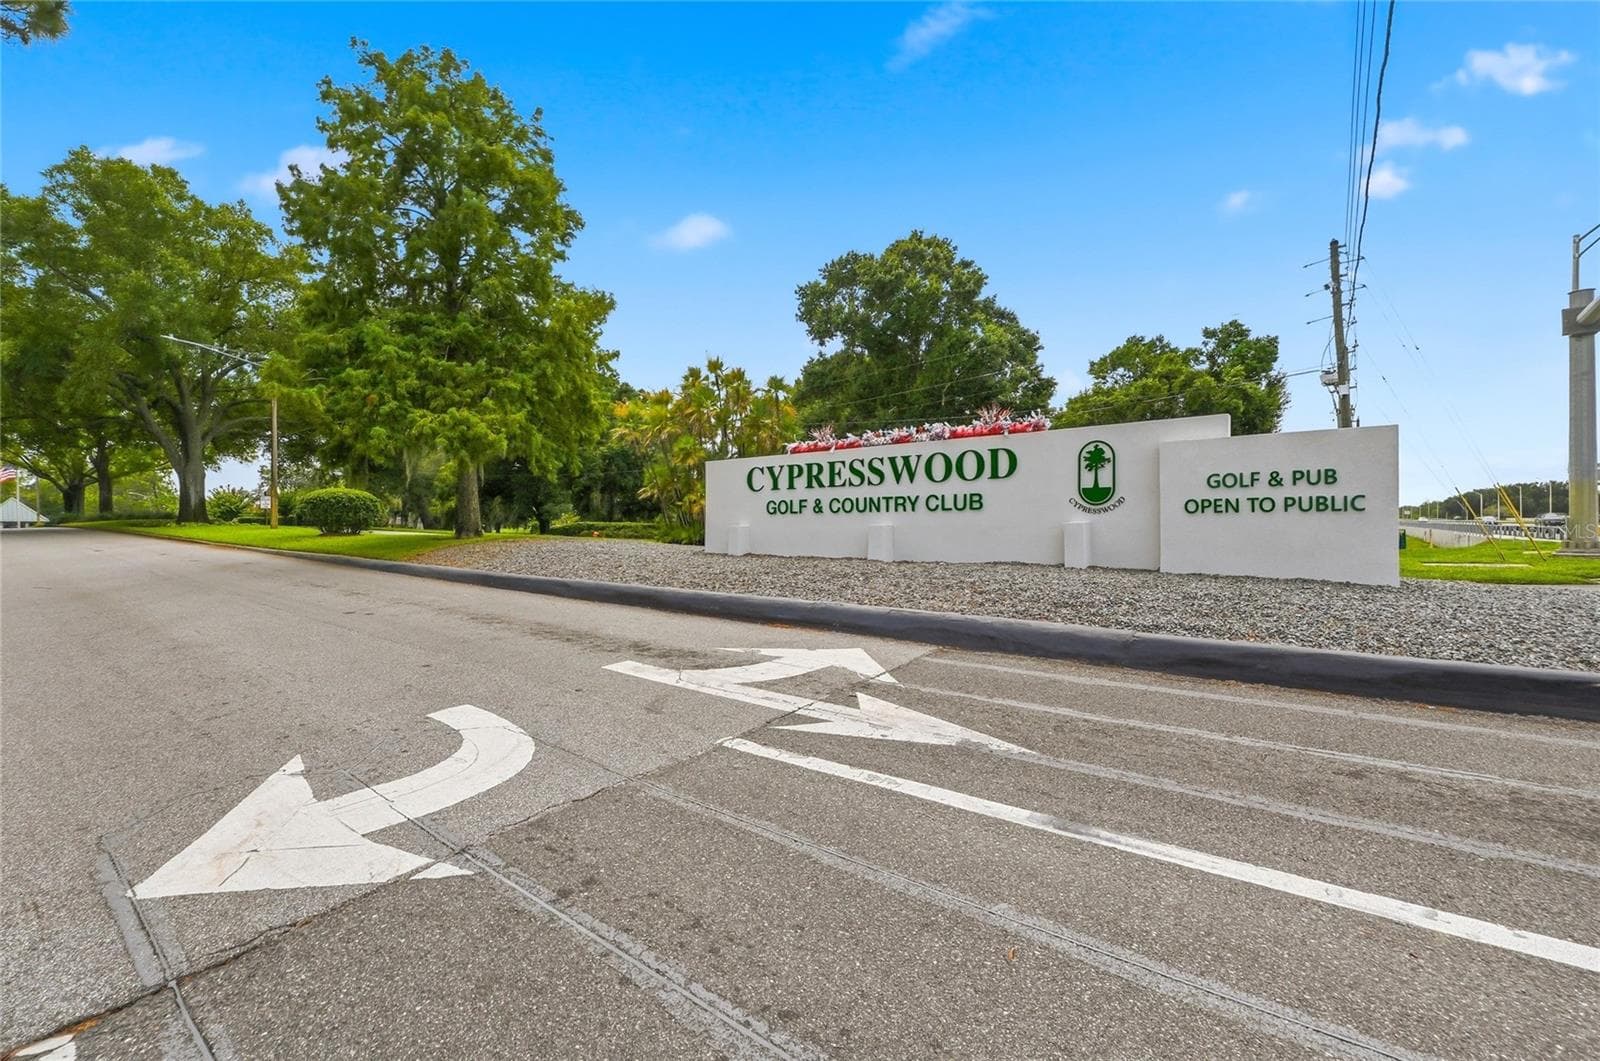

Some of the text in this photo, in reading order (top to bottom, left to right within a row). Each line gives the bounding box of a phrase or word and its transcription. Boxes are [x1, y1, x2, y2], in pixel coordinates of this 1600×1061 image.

[746, 447, 1018, 492] CYPRESSWOOD
[1206, 468, 1338, 489] GOLF & PUB
[766, 492, 984, 516] GOLF & COUNTRY CLUB
[1068, 496, 1126, 515] CYPRESSWOOD
[1184, 494, 1366, 515] OPEN TO PUBLIC
